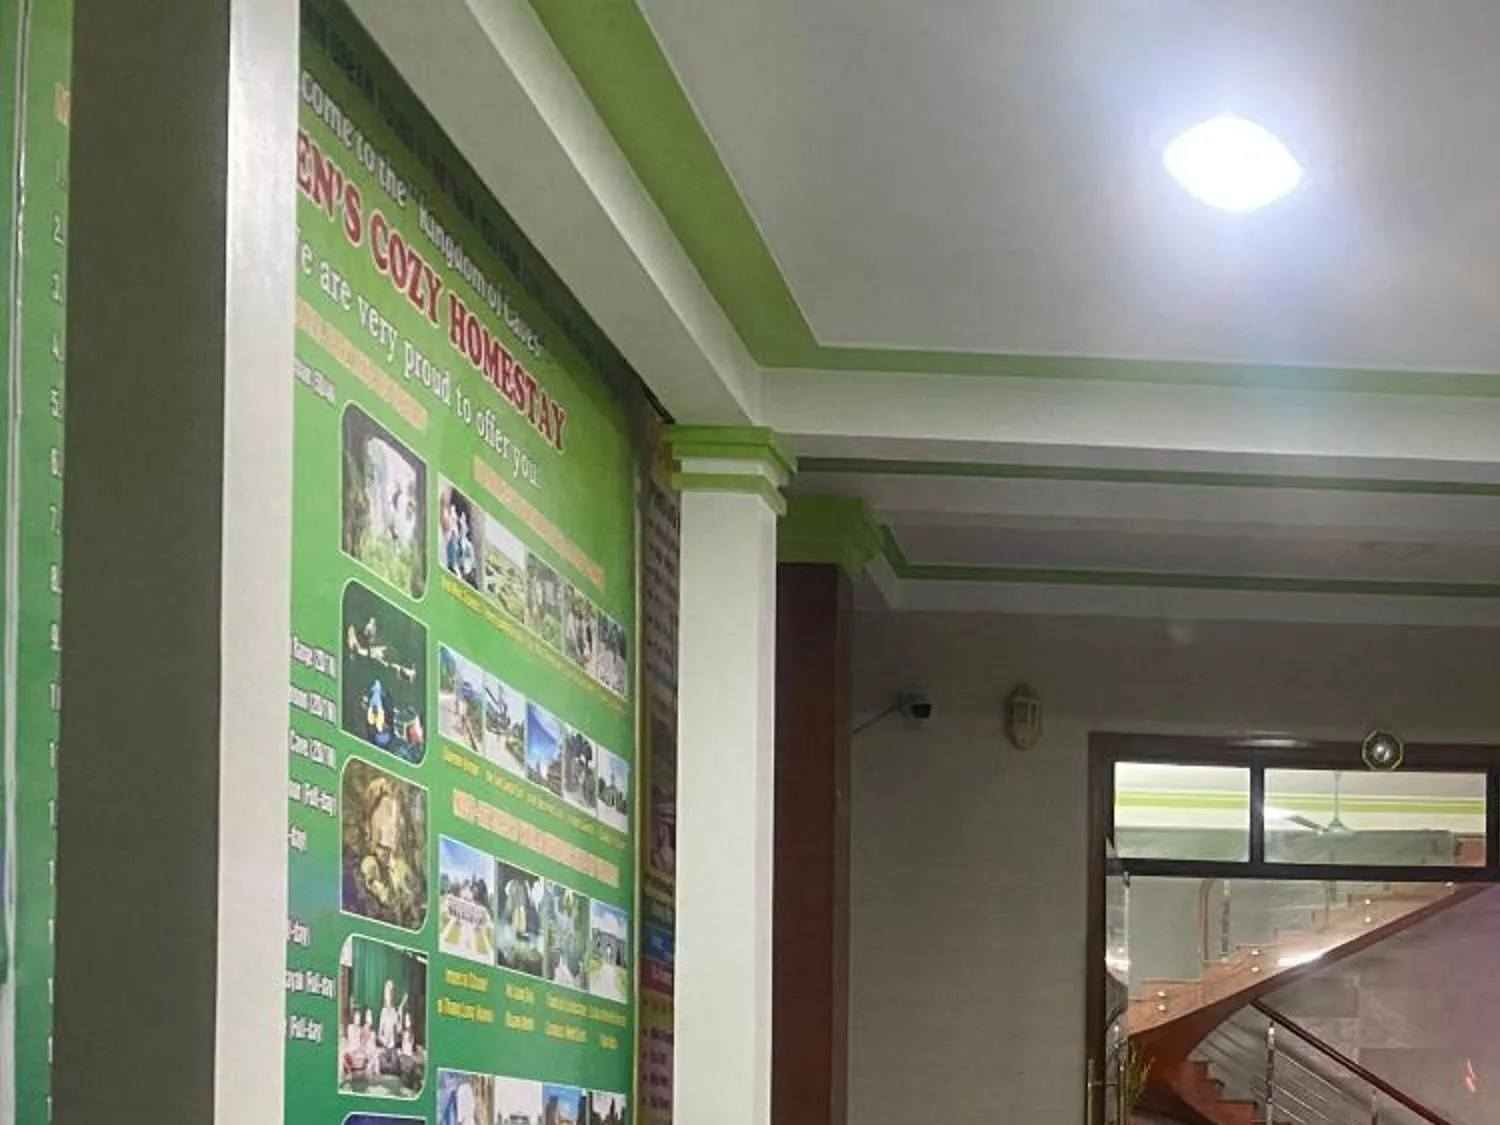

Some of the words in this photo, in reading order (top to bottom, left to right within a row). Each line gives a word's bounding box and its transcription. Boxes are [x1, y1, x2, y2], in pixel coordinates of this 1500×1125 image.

[301, 68, 352, 148] come
[297, 126, 364, 248] EN'S
[367, 207, 443, 329] COZY
[447, 289, 568, 456] HOMESTAY
[319, 260, 352, 312] are
[356, 295, 398, 363] very
[403, 340, 451, 408] proud
[454, 384, 472, 425] to
